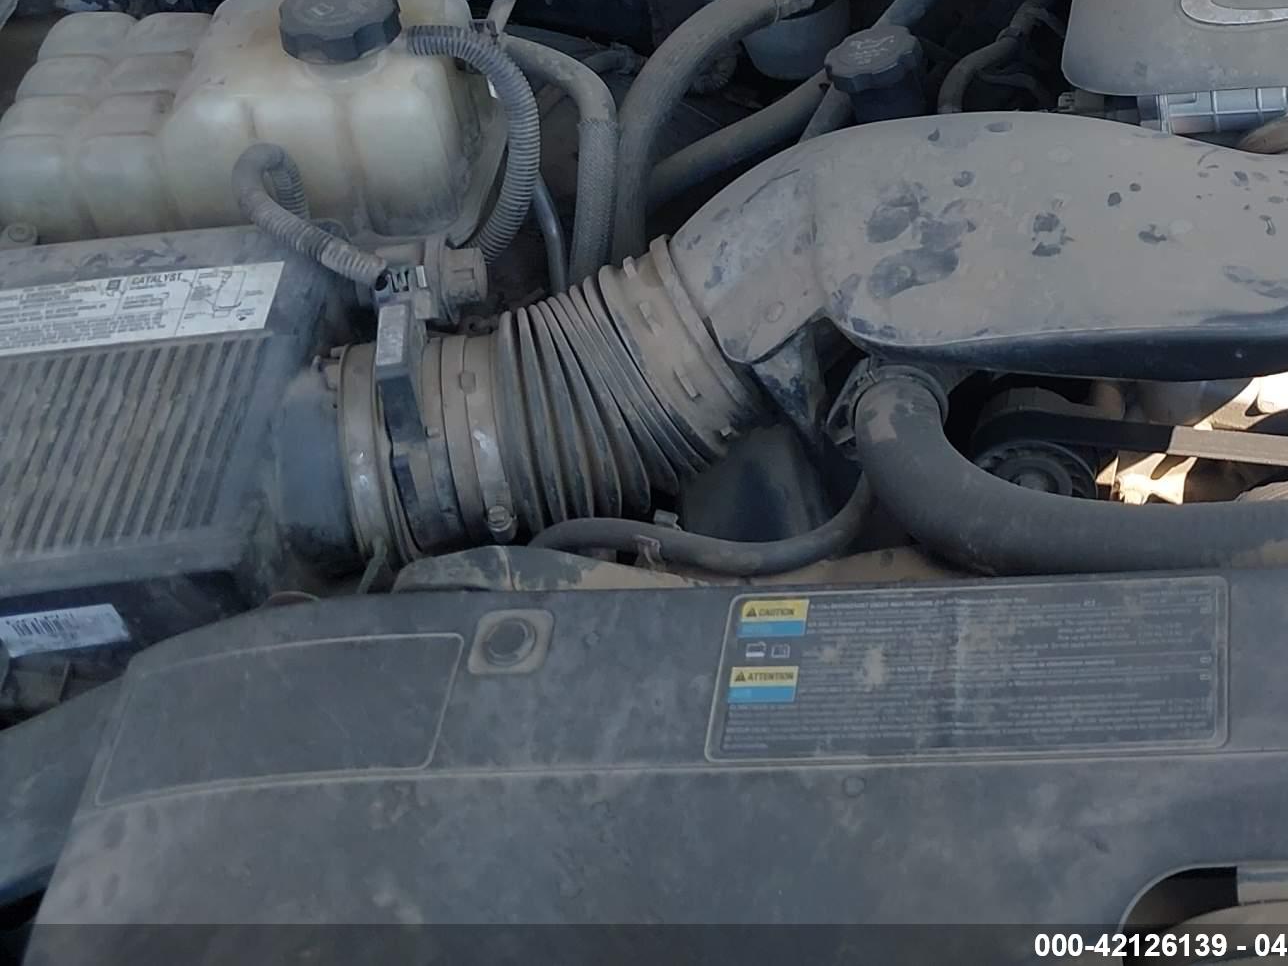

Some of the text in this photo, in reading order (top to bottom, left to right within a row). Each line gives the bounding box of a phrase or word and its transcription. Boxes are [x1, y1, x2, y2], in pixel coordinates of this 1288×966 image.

[132, 272, 183, 285] CATALYST
[758, 608, 795, 618] CAUTION
[747, 671, 795, 682] ATTENTION
